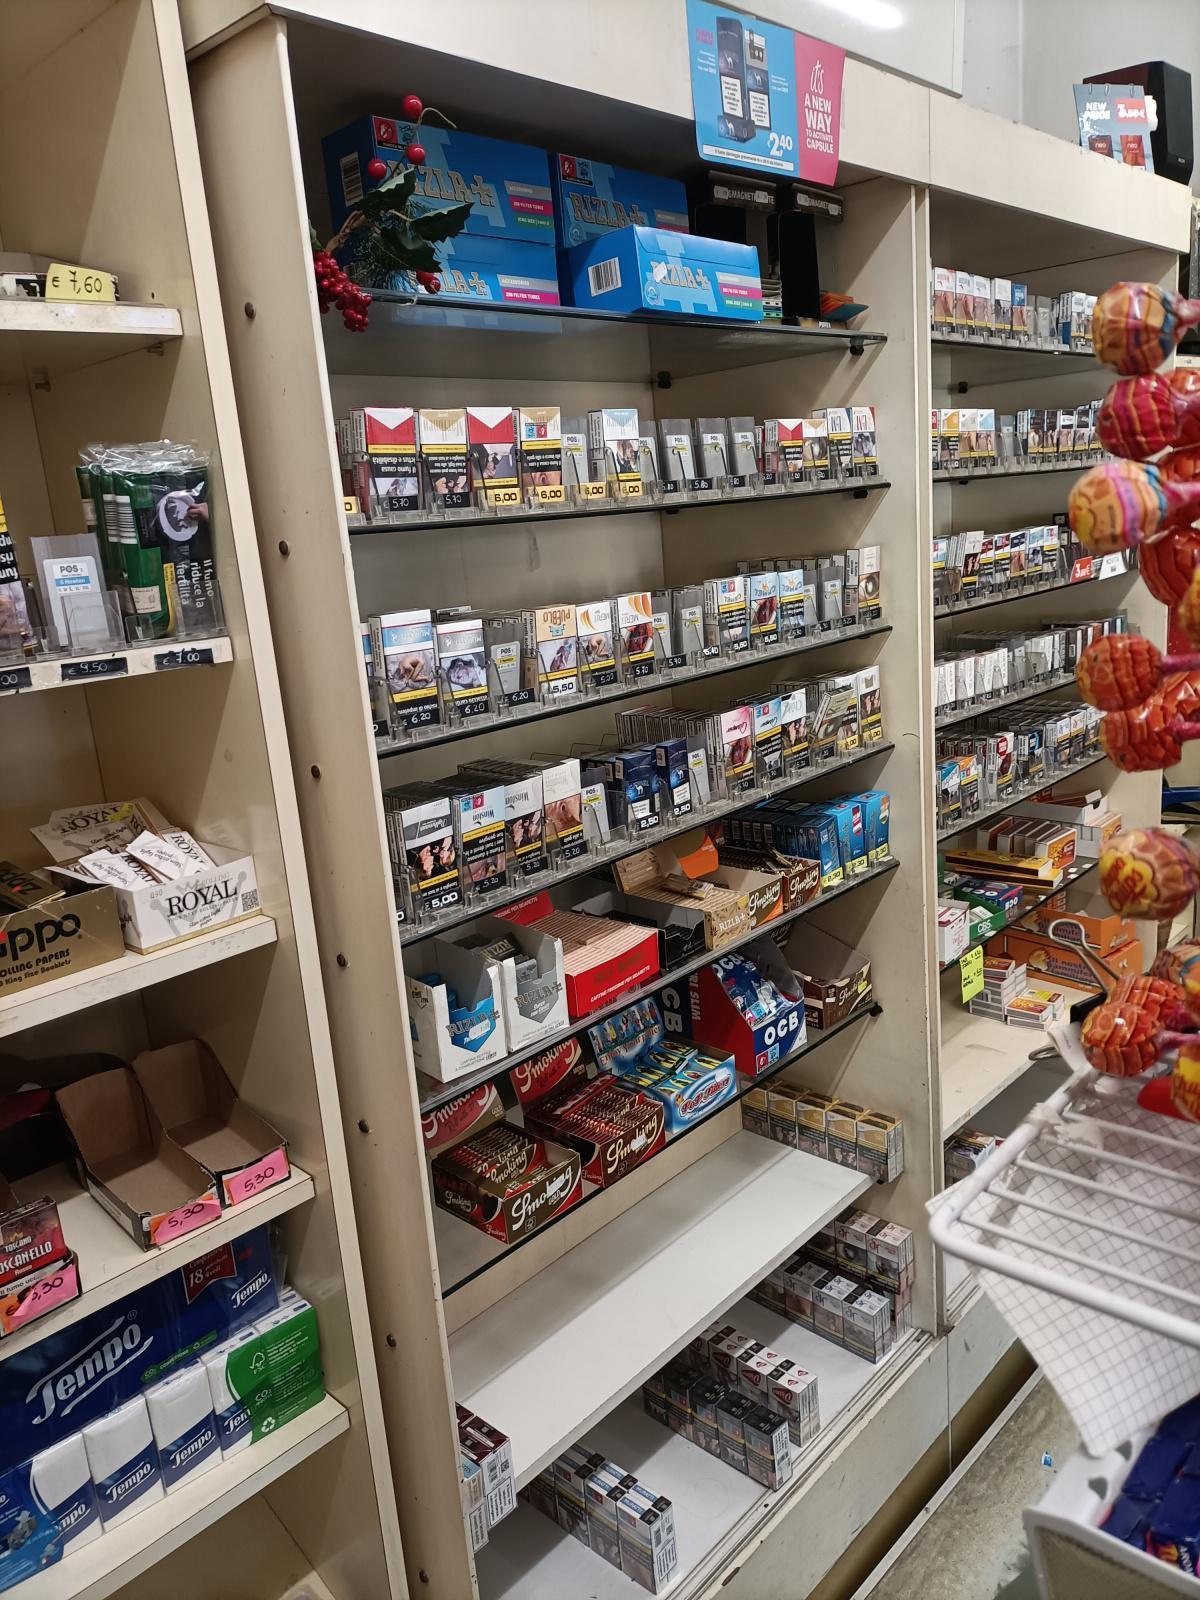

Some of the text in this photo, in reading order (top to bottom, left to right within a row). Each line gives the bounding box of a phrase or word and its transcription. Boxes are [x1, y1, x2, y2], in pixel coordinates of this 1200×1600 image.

[810, 60, 825, 94] it's
[805, 94, 832, 112] A NEW
[805, 108, 832, 132] WAY
[806, 140, 834, 154] CAPSULE
[812, 131, 833, 142] ACTIVATE
[69, 270, 103, 294] 7,60
[495, 492, 517, 502] 6,00
[541, 489, 562, 499] 6,00
[60, 564, 79, 574] POS
[190, 562, 205, 608] riduce la
[203, 569, 215, 598] fumo
[543, 607, 571, 625] PUEBLO
[500, 647, 512, 655] POS
[512, 691, 529, 702] 6.20
[552, 682, 574, 693] 5,50
[411, 713, 431, 724] 6.20
[464, 703, 485, 714] 6.20
[473, 808, 494, 822] Winston
[673, 804, 691, 816] 2,50
[640, 816, 659, 828] 2,50
[790, 865, 819, 899] Smoking
[165, 879, 238, 917] ROYAL
[432, 892, 459, 908] 5,00
[749, 882, 781, 914] Smoking
[719, 912, 746, 933] RIZLA+
[35, 948, 70, 967] PAPERS
[5, 973, 23, 985] King
[41, 959, 72, 974] Booklets
[515, 982, 563, 1009] RIZLA+
[661, 987, 683, 1033] CB
[764, 1011, 799, 1046] OCB
[244, 1166, 275, 1192] 5,30
[167, 1202, 205, 1228] 5,30
[5, 1236, 32, 1253] TOSCANO
[189, 1267, 204, 1288] 18
[232, 1271, 271, 1308] Tempo
[26, 1315, 146, 1424] Tempo
[169, 1428, 215, 1470] Tempo
[106, 1461, 155, 1504] Tempo
